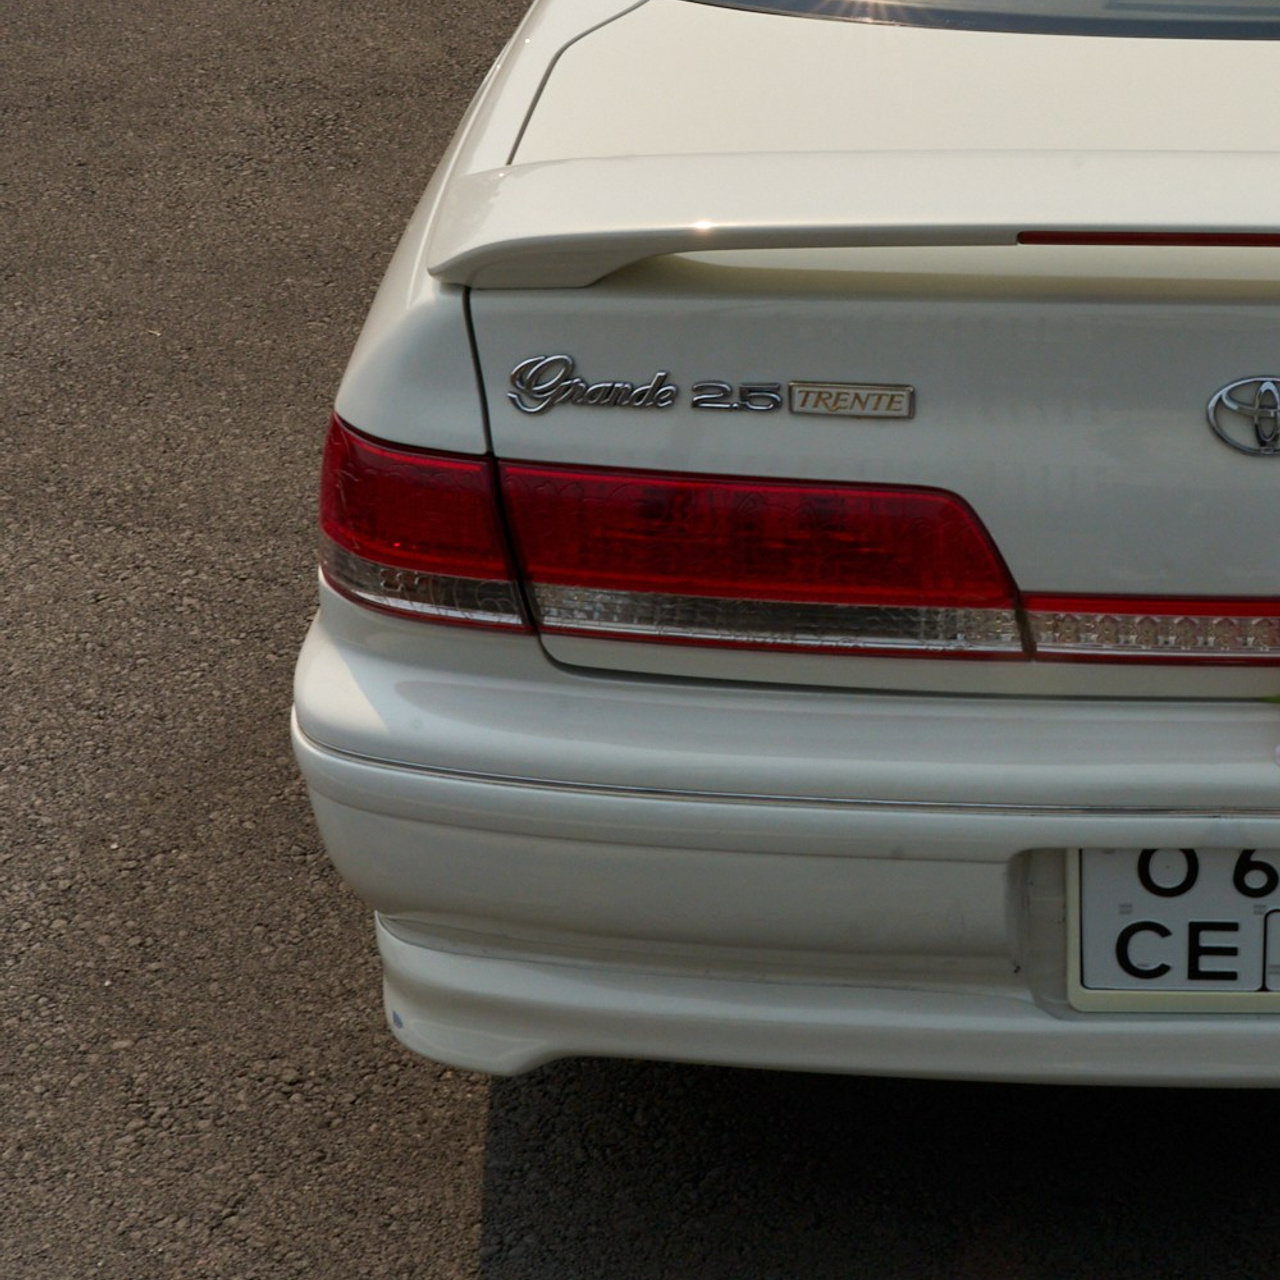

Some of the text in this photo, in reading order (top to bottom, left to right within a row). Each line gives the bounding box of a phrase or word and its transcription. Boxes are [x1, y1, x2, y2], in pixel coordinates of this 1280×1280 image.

[507, 354, 905, 415] Grande 2.5 TRENTE
